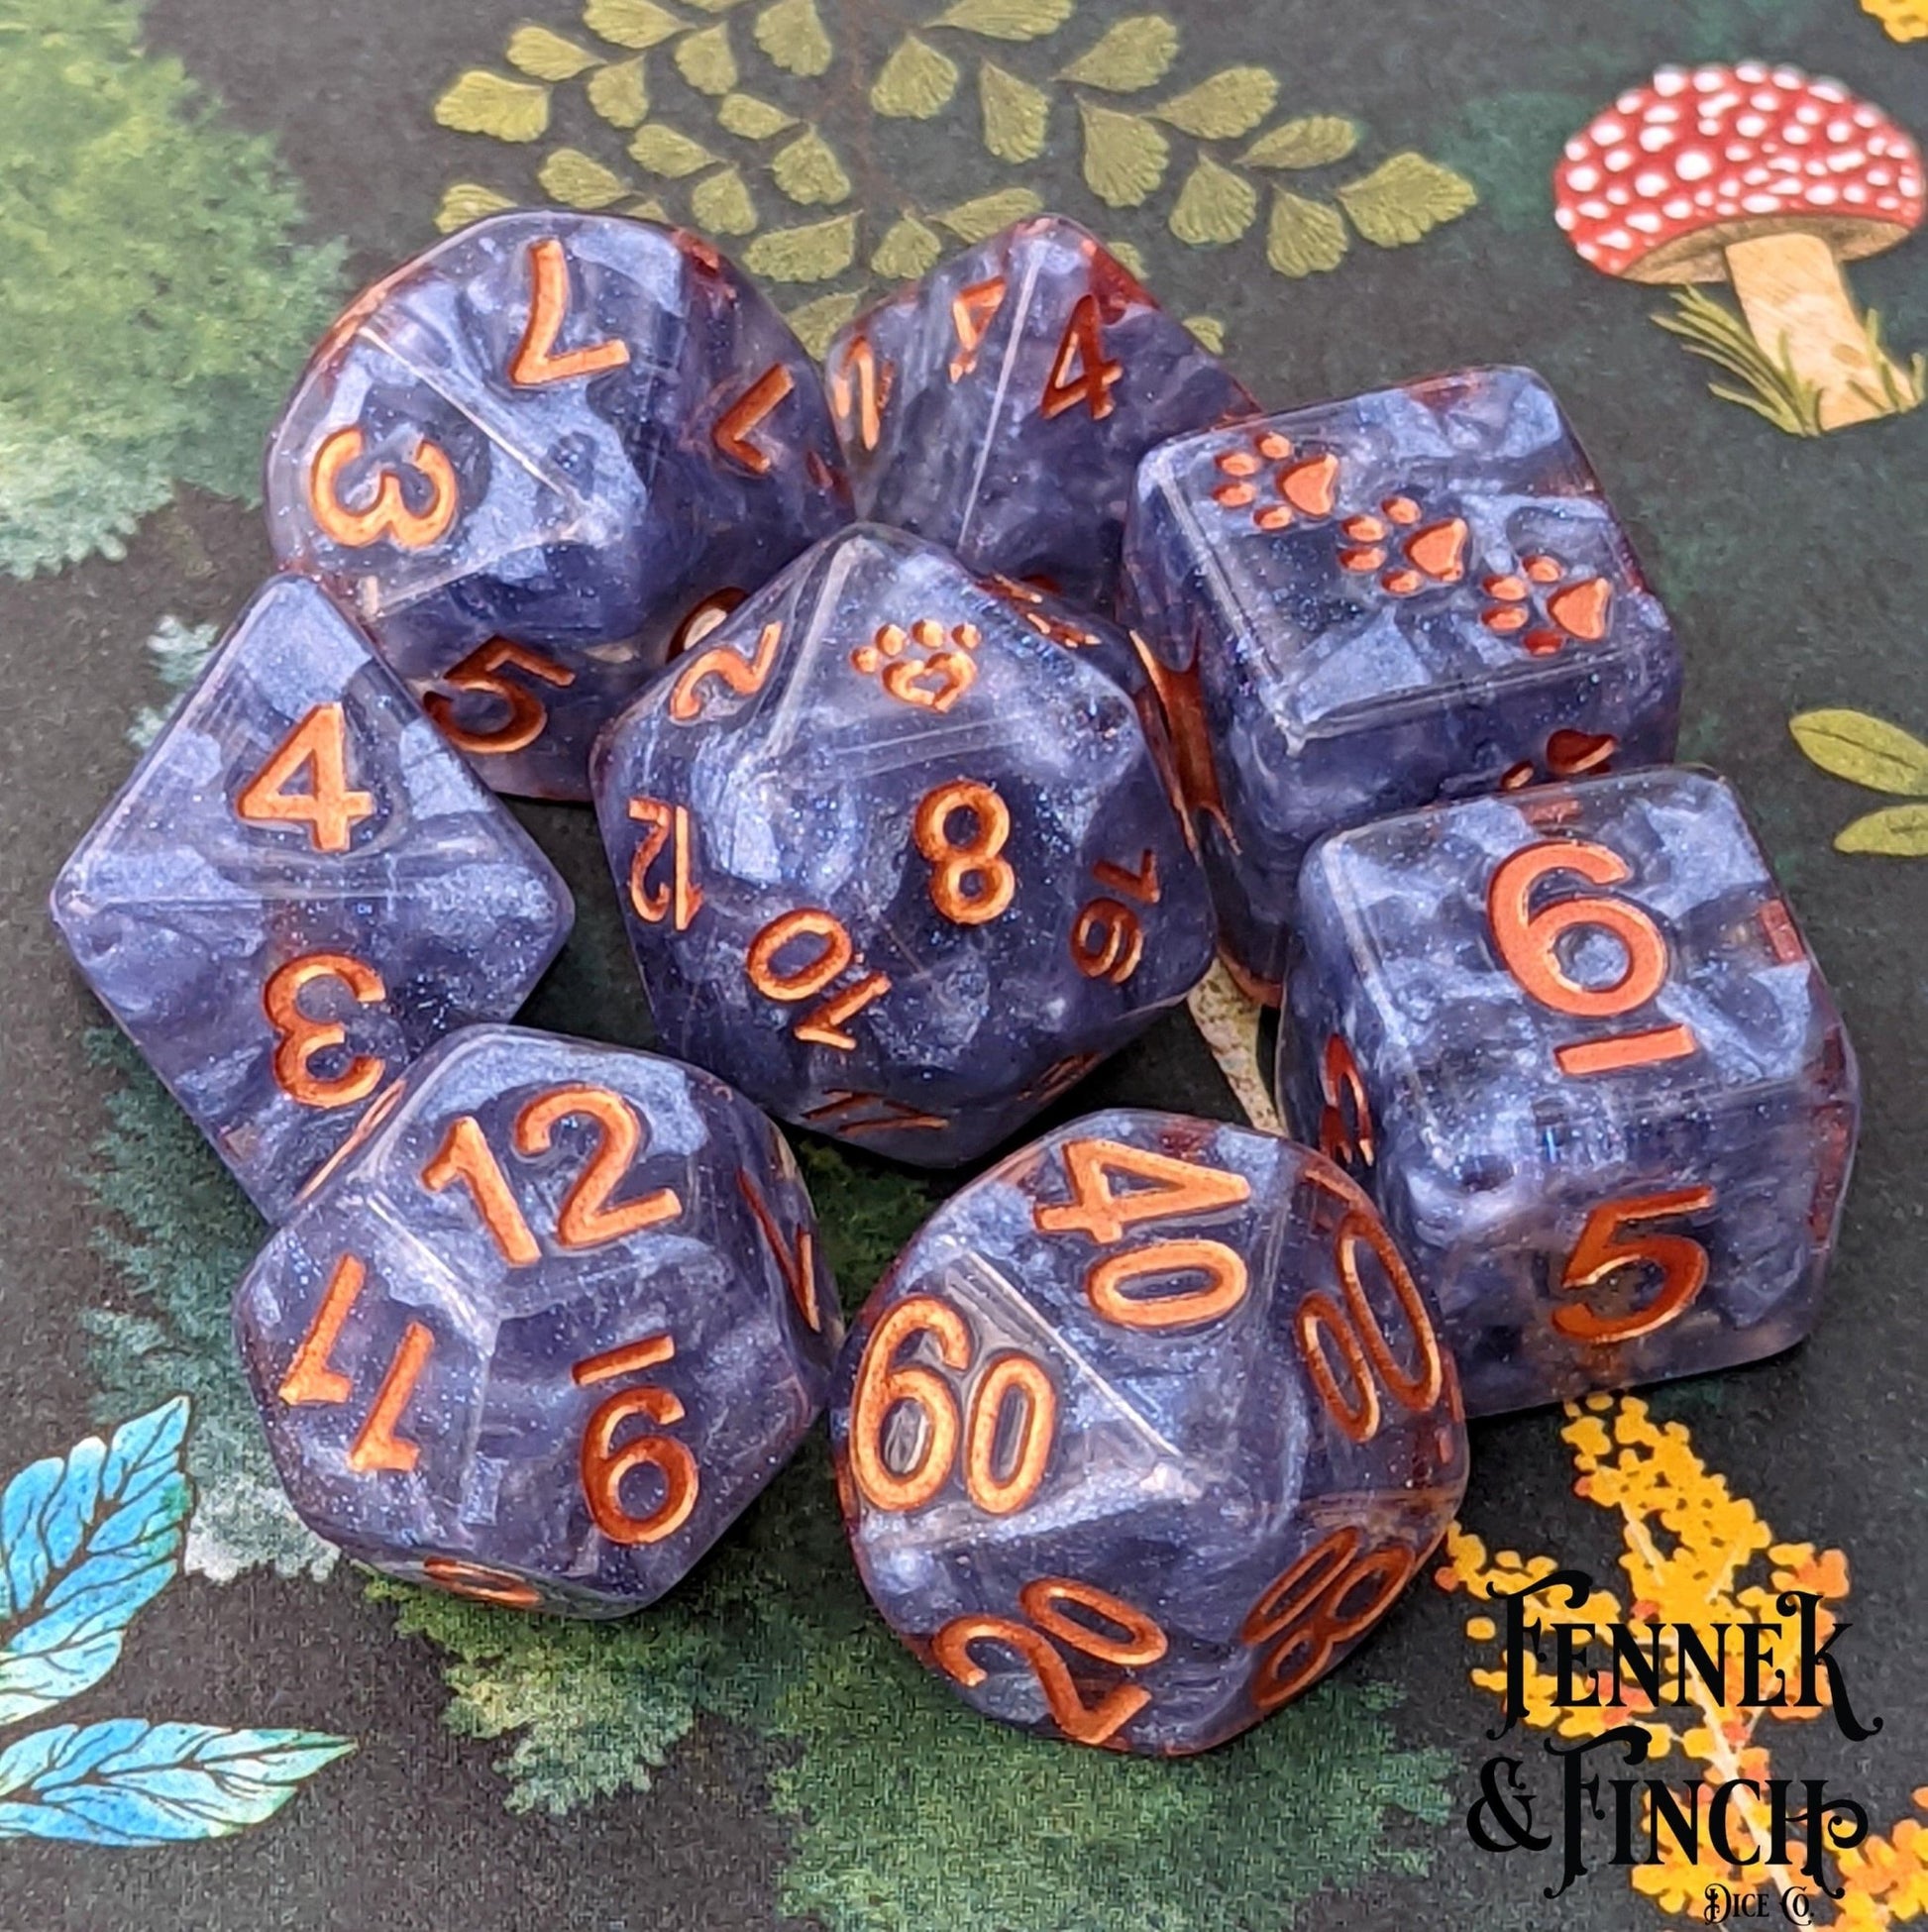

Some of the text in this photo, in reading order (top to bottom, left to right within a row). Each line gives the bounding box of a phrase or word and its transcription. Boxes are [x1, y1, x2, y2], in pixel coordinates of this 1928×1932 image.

[1040, 293, 1124, 420] 4
[310, 426, 459, 549] 3
[423, 634, 577, 754] 5
[670, 620, 783, 721] 2
[236, 701, 375, 853] 4
[913, 779, 1016, 926] 8
[746, 907, 892, 1050] 10
[1489, 839, 1668, 1018] 6
[263, 953, 386, 1109] 3
[421, 1082, 683, 1266] 12
[1032, 1137, 1251, 1329] 40
[1552, 1186, 1716, 1344] 5
[278, 1253, 436, 1473] 11
[849, 1295, 1058, 1516] 60
[932, 1577, 1169, 1744] 20
